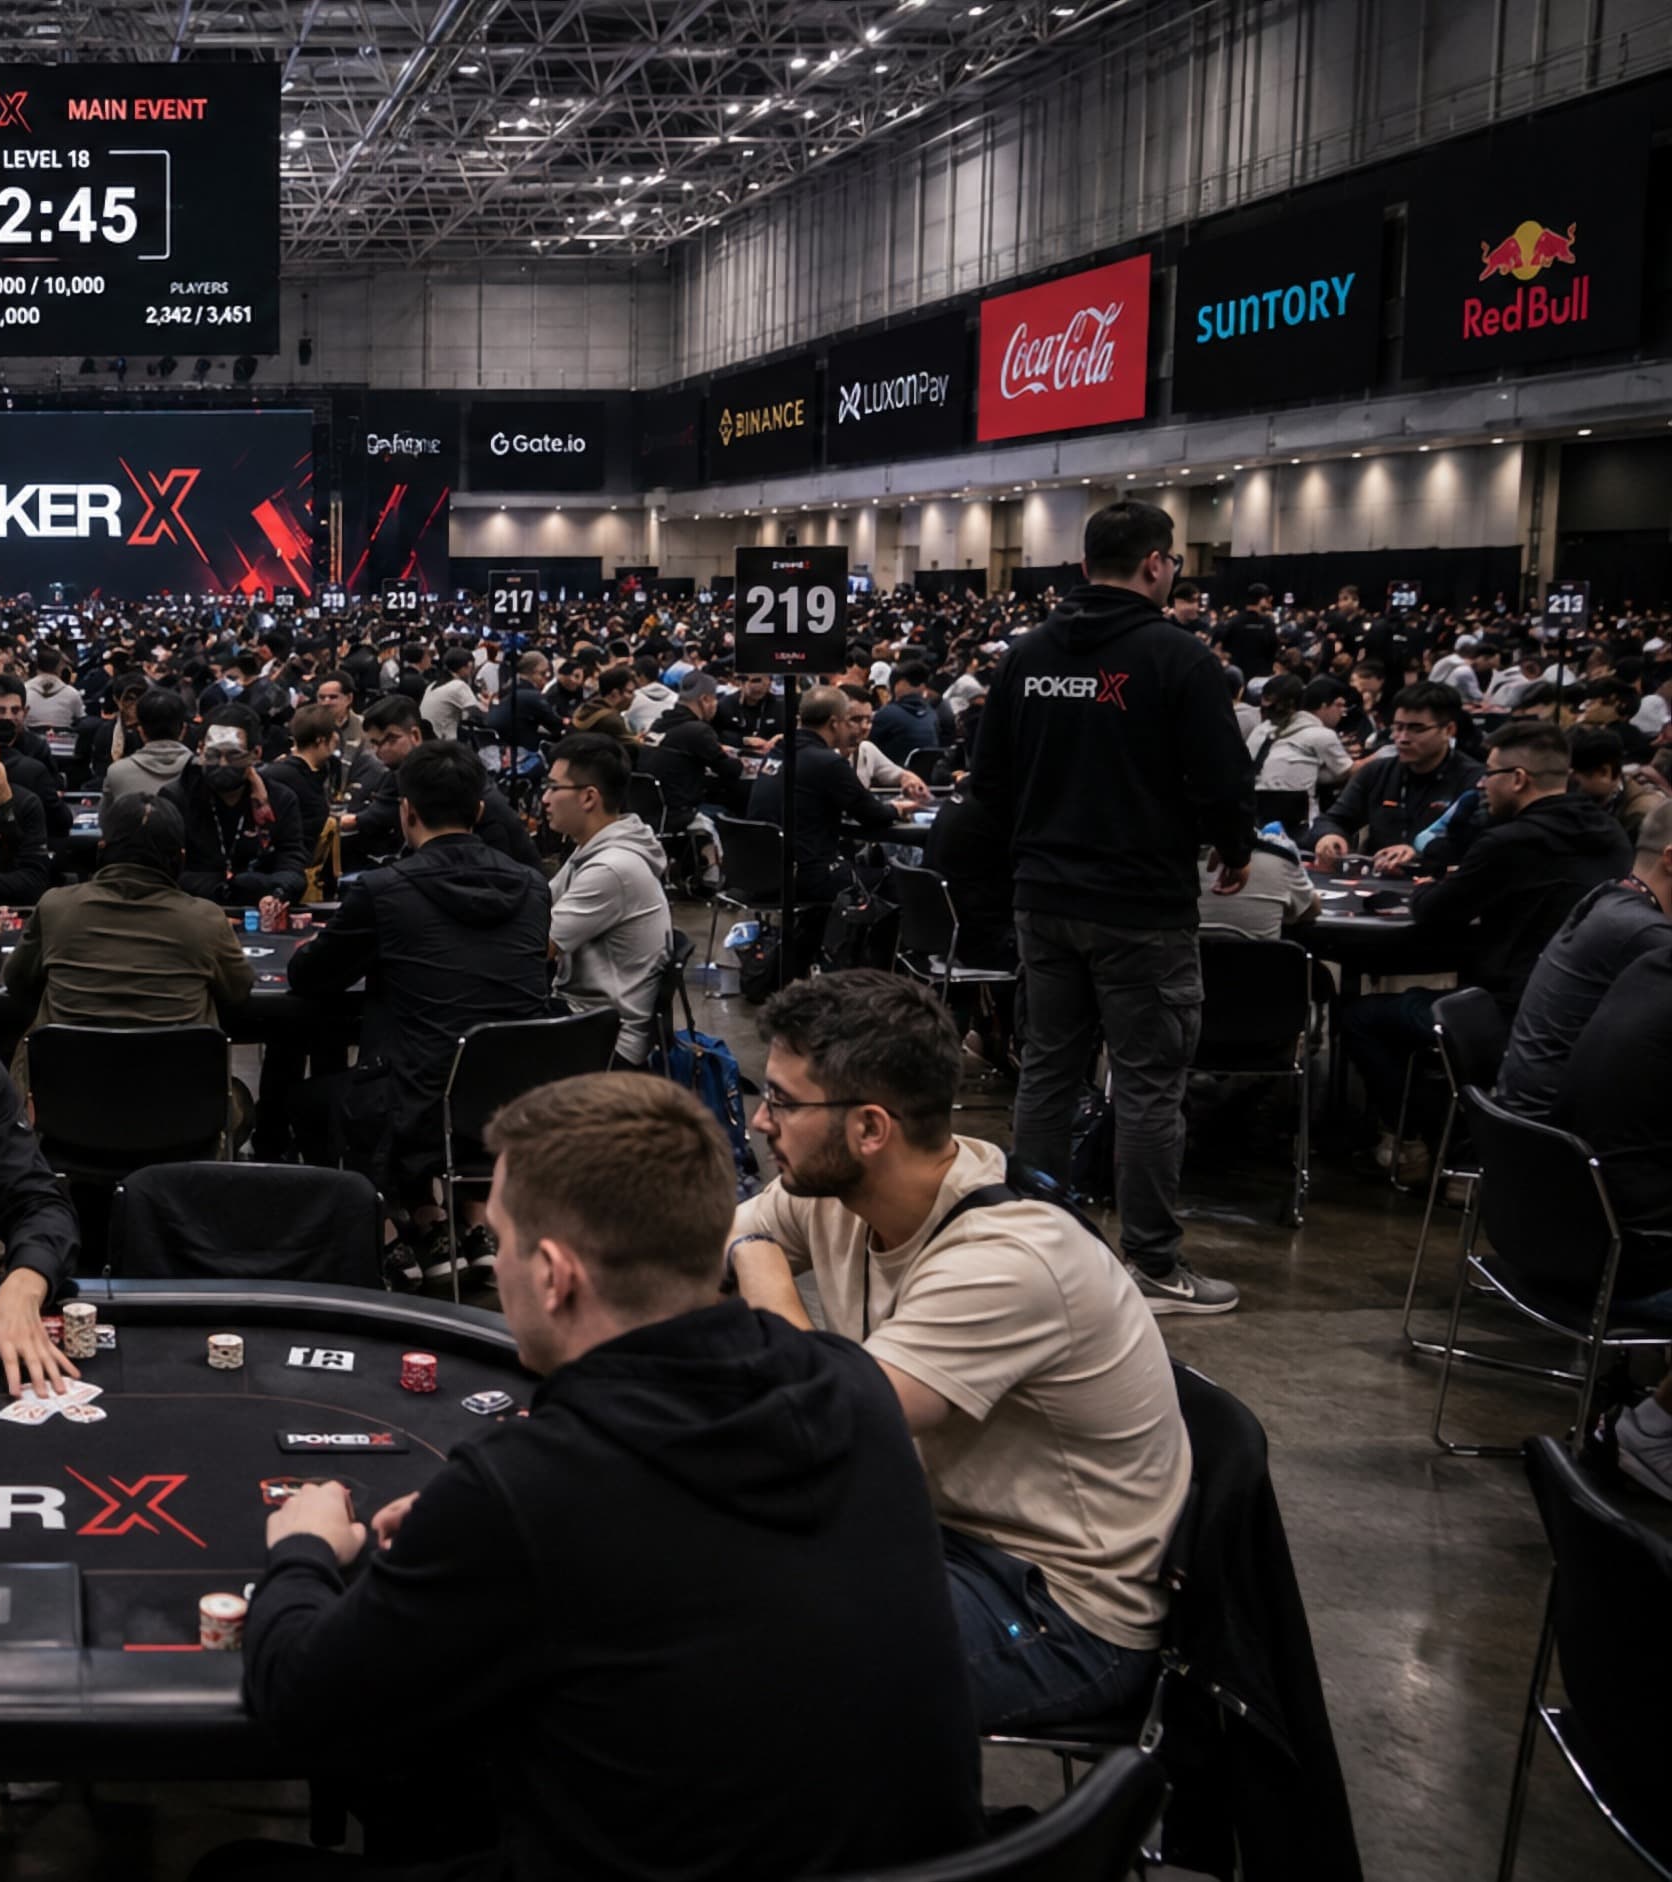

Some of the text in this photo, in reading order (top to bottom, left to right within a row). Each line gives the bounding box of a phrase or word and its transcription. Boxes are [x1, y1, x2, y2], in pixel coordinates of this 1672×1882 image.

[68, 98, 208, 120] MAIN EVENT
[3, 150, 90, 169] LEVEL 18
[46, 276, 105, 297] 10,000
[169, 281, 229, 295] PLAYERS
[734, 398, 805, 438] BINANCE
[512, 434, 586, 453] Gate.io
[493, 589, 534, 613] 217
[745, 585, 837, 634] 219
